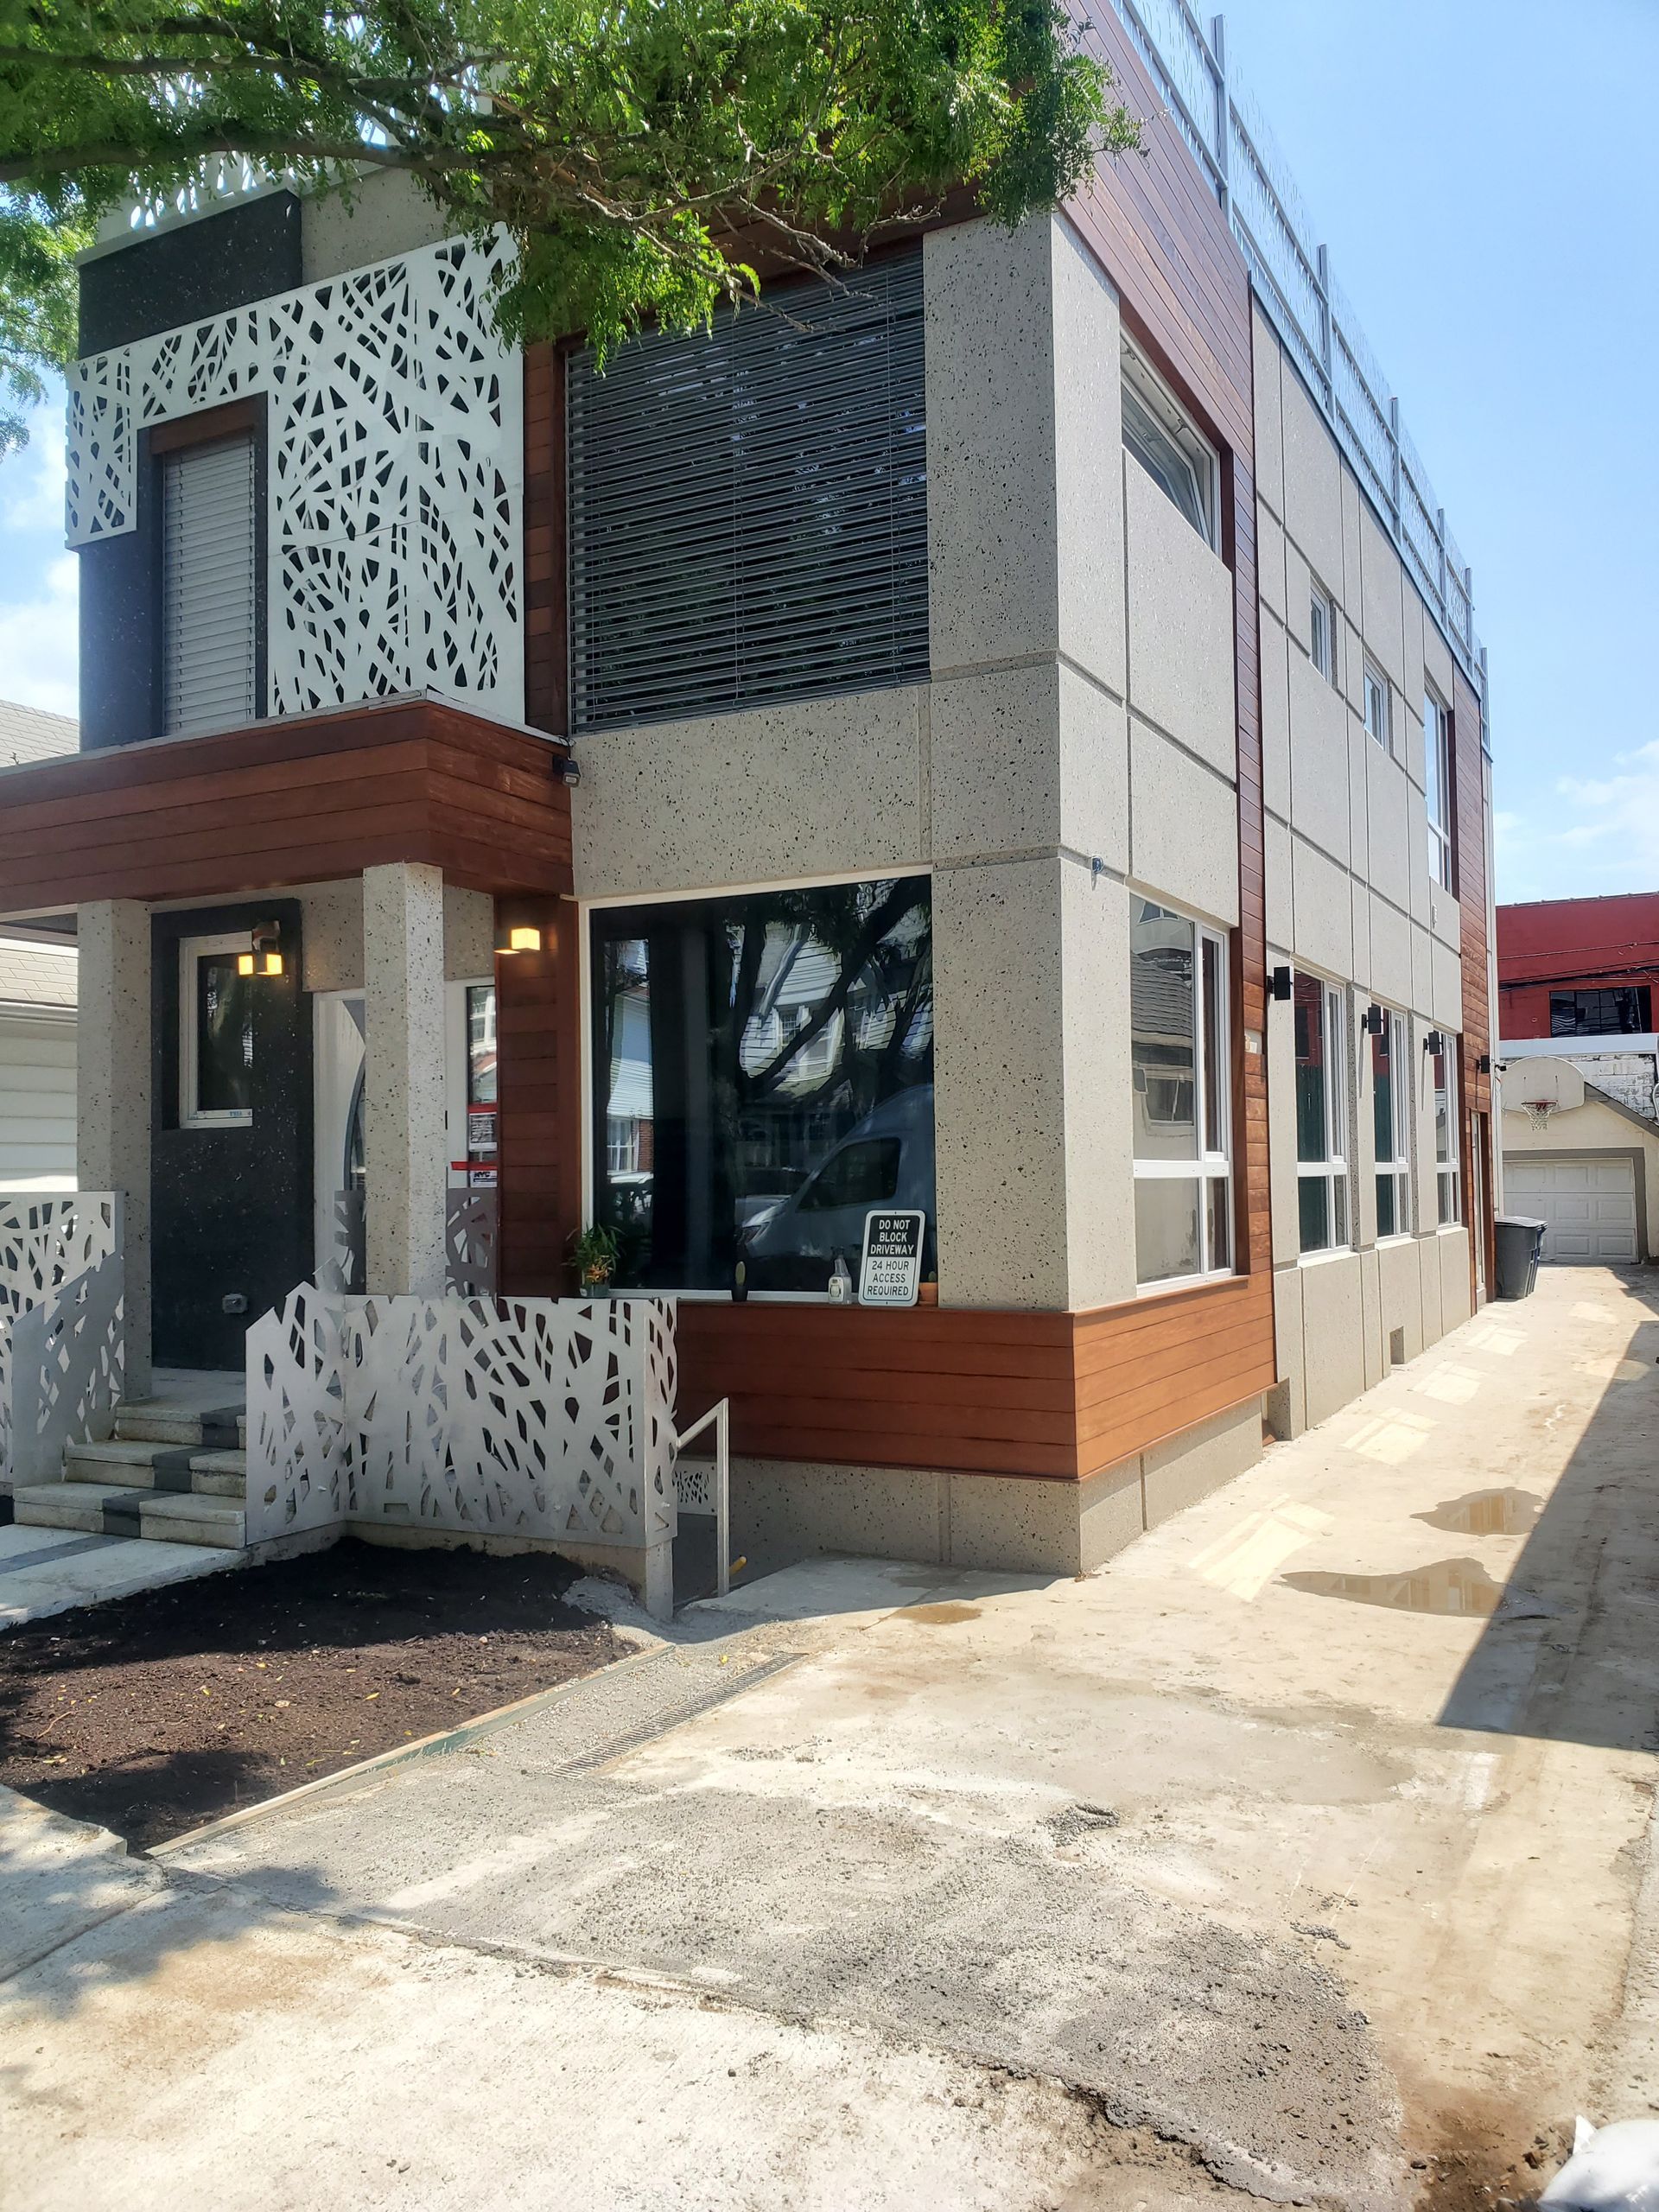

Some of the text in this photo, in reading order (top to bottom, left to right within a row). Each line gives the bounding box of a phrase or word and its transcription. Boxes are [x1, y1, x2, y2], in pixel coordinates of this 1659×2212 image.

[879, 1219, 911, 1230] DO NOT
[879, 1231, 907, 1243] BLOCK
[870, 1244, 914, 1255] DRIVEWAY
[872, 1261, 910, 1271] 24 HOUR
[872, 1273, 906, 1283] ACCESS
[867, 1285, 909, 1296] REQUIRED
